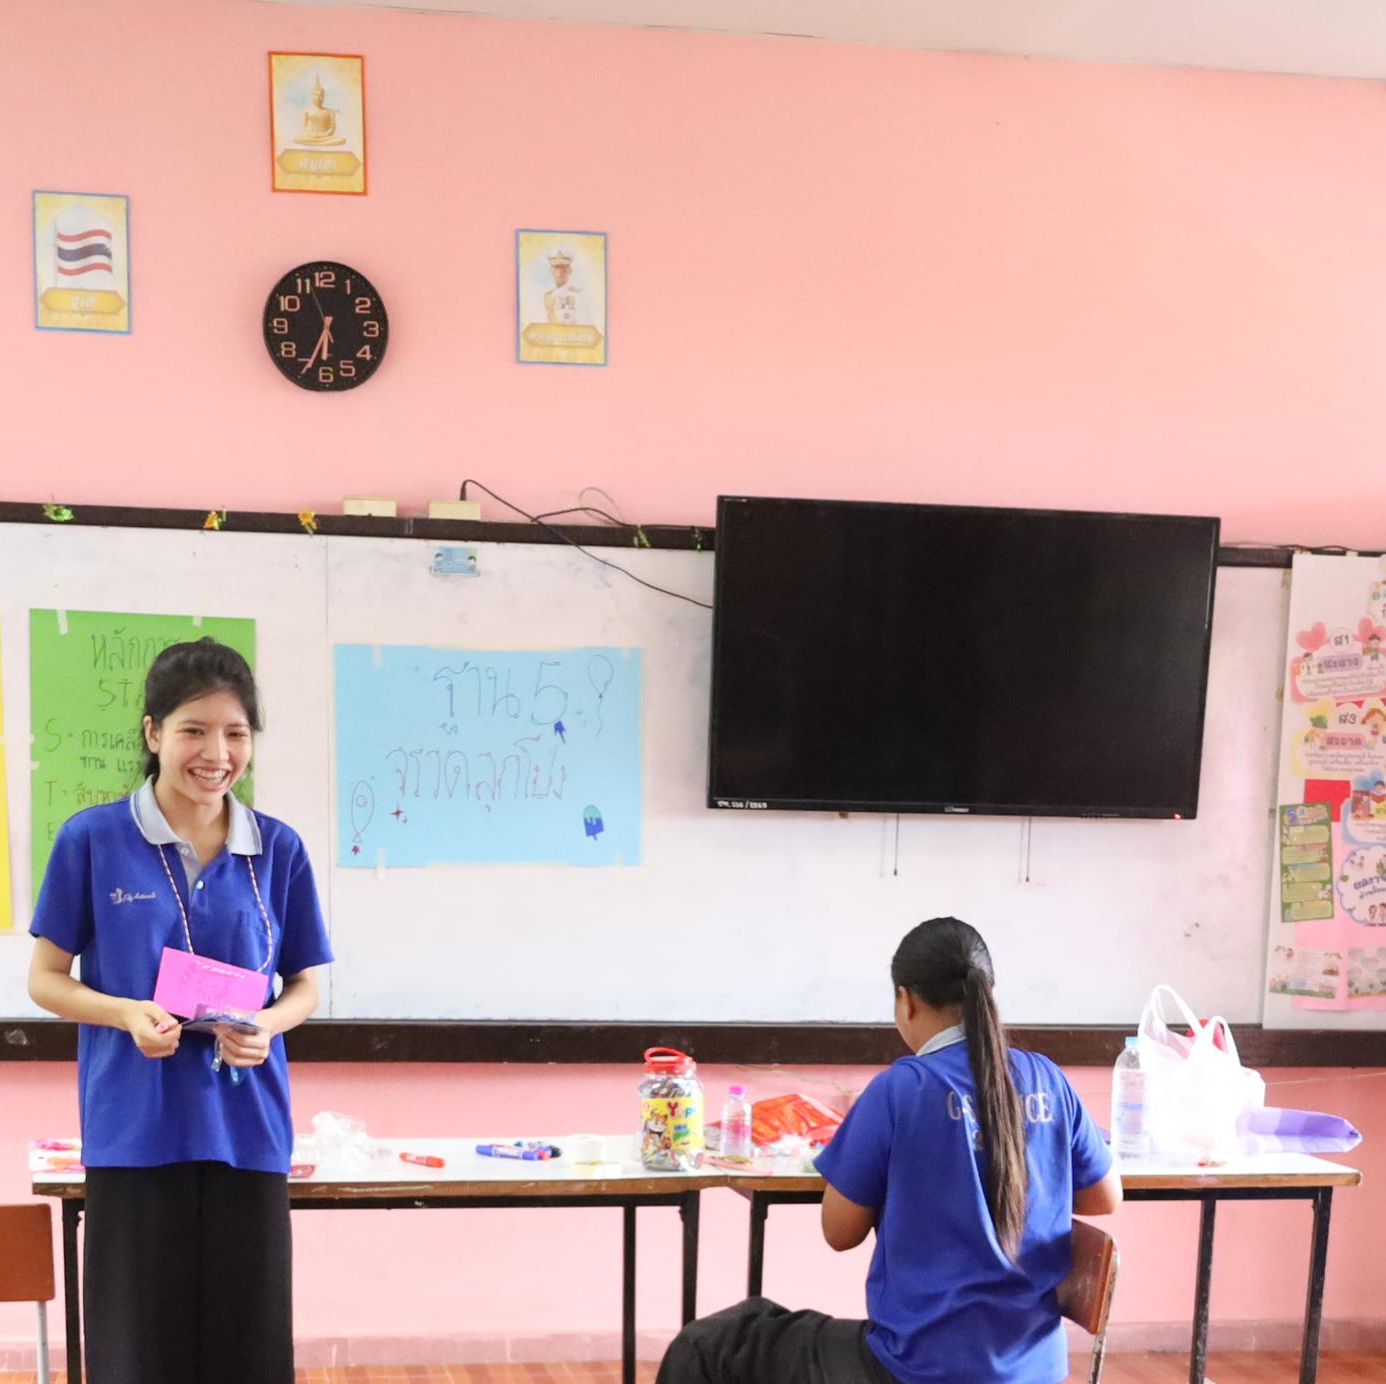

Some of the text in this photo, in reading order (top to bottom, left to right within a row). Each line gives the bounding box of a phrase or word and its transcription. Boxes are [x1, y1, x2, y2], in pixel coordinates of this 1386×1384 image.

[296, 278, 311, 294] 11
[315, 271, 335, 288] 12
[345, 279, 351, 295] 1
[279, 295, 300, 312] 10
[355, 297, 371, 314] 2
[273, 318, 288, 334] 9
[363, 321, 379, 337] 3
[281, 341, 297, 358] 8
[356, 344, 372, 360] 4
[319, 366, 333, 383] 6
[340, 360, 355, 377] 5
[91, 627, 181, 671] หลักก
[531, 661, 569, 725] 5
[1338, 713, 1357, 725] ส3
